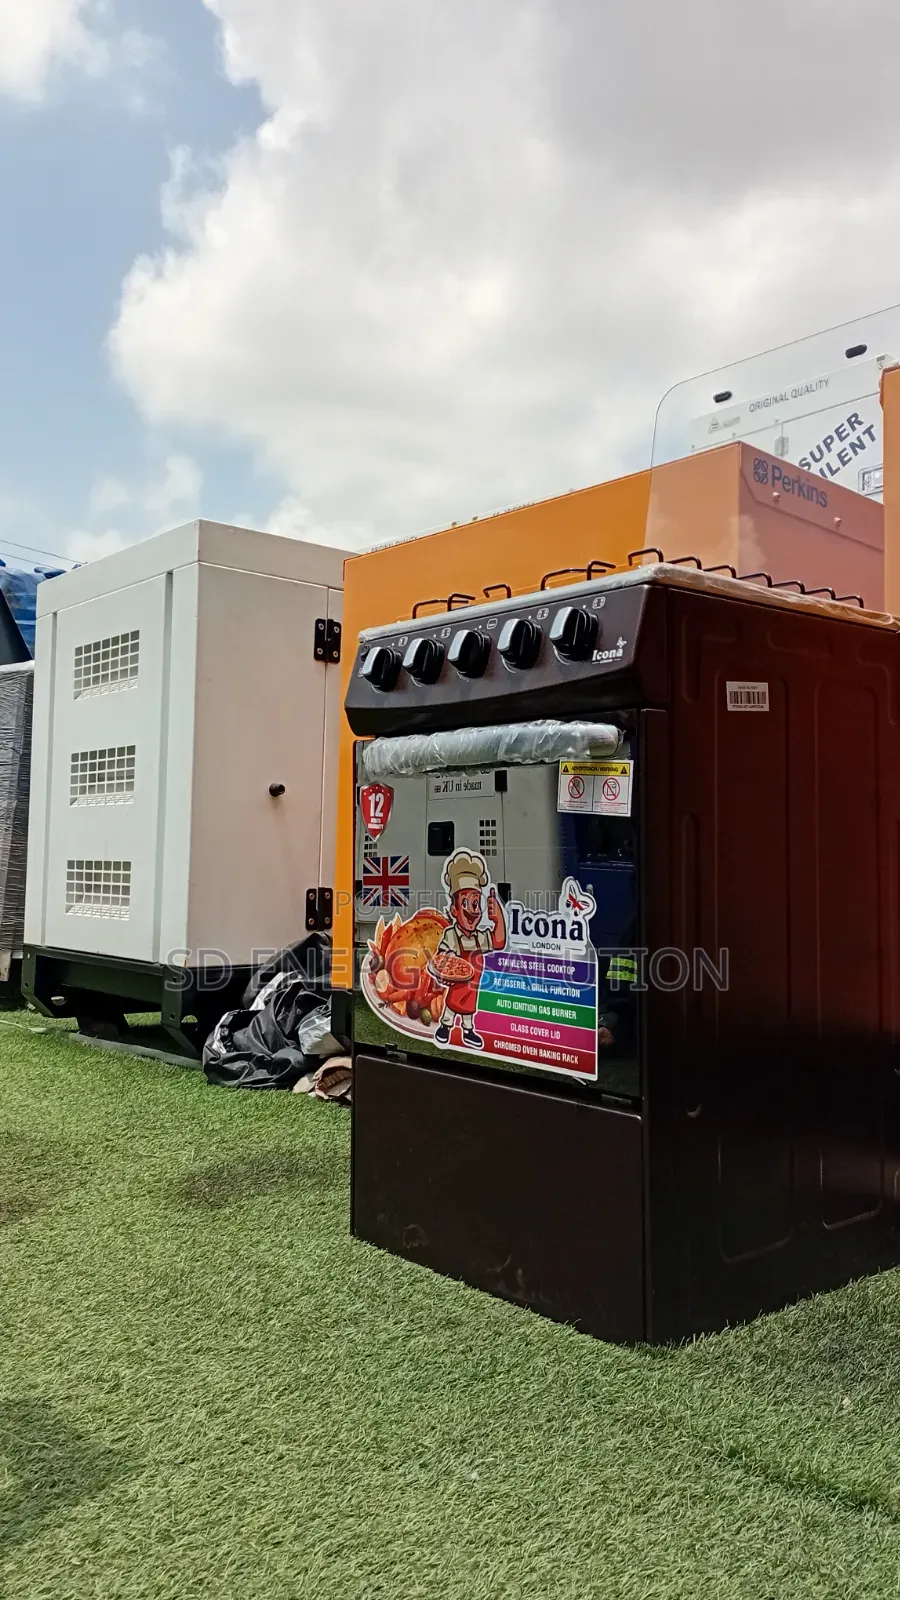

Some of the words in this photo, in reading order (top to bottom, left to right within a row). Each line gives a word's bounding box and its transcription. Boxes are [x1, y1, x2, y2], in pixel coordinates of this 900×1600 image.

[748, 392, 789, 413] ORIGINAL
[790, 378, 830, 399] QUALITY
[798, 412, 864, 471] SUPER
[819, 424, 876, 479] ILENT
[770, 464, 829, 508] Perkins
[591, 648, 624, 661] Icona
[368, 792, 385, 817] 12
[511, 908, 584, 941] Icona
[532, 942, 561, 951] LONDON
[497, 957, 527, 970] STAINLESS
[528, 962, 546, 972] STEEL
[547, 965, 576, 976] COOKTOP
[493, 977, 526, 990] ROTISSERIE
[531, 982, 548, 994] GRILL
[549, 986, 581, 999] FUNCTION
[496, 999, 512, 1009] AUTO
[512, 1002, 538, 1014] IGNITION
[538, 1006, 551, 1016] GAS
[551, 1009, 577, 1021] BURNER
[510, 1022, 529, 1034] GLASS
[529, 1027, 550, 1038] COVER
[550, 1030, 561, 1040] LID
[493, 1039, 522, 1053] CHROMED
[522, 1046, 538, 1056] OVEN
[538, 1049, 561, 1061] BAKING
[562, 1053, 579, 1065] RACK
